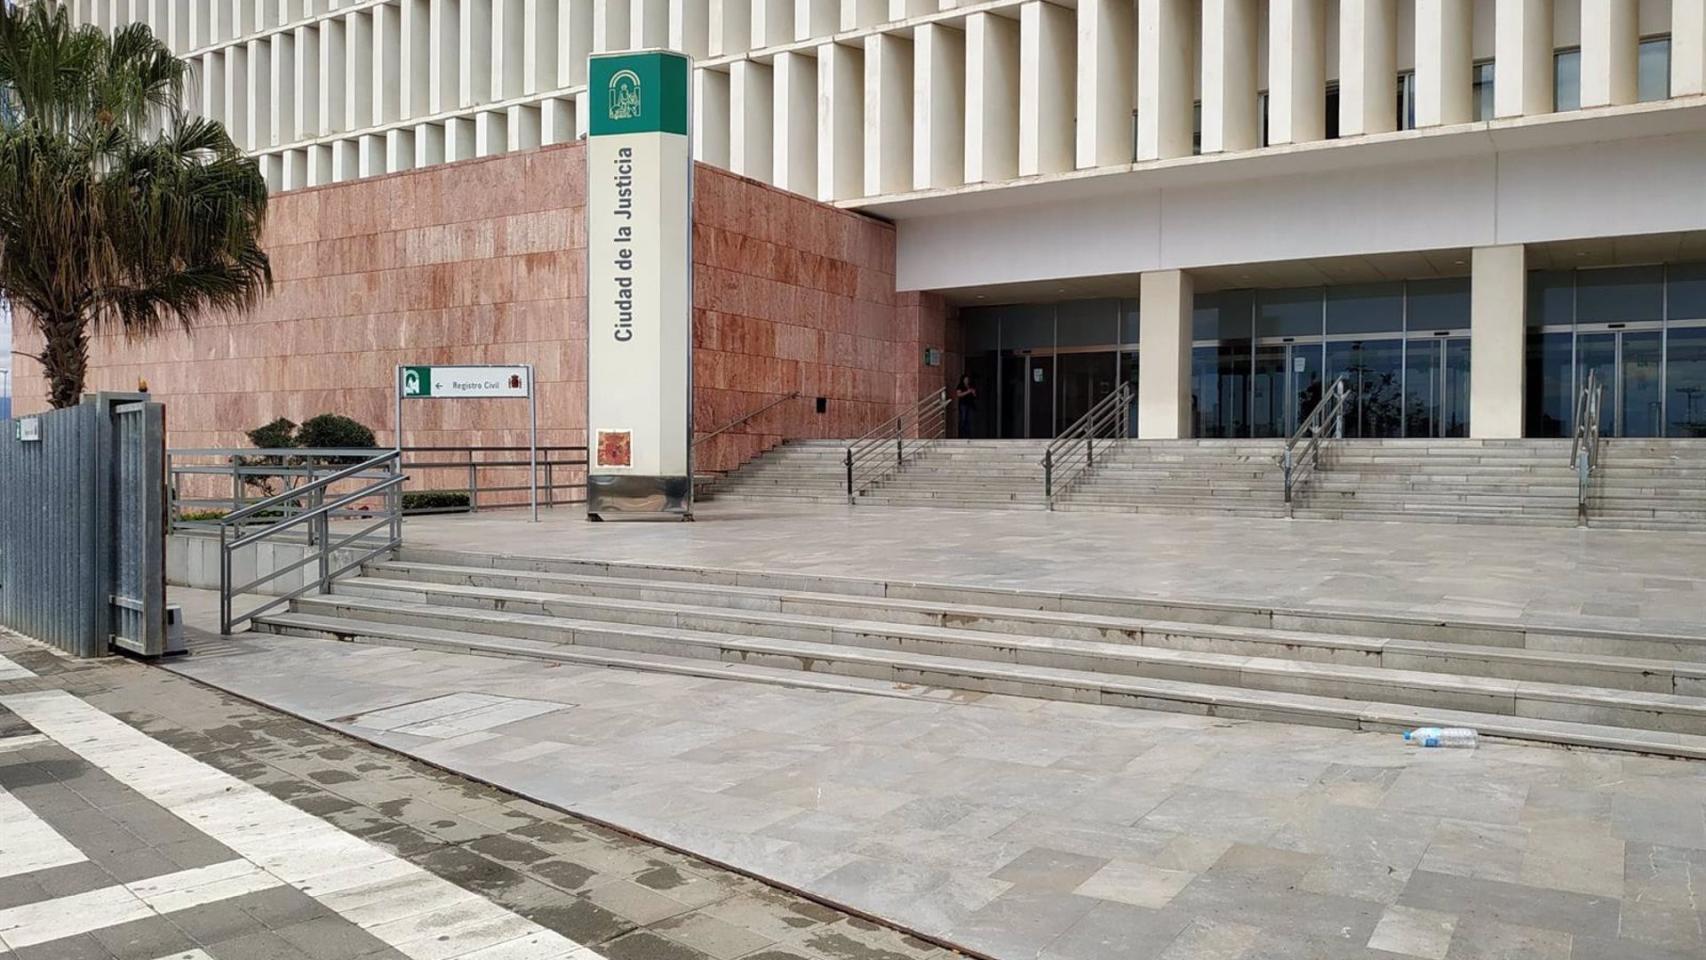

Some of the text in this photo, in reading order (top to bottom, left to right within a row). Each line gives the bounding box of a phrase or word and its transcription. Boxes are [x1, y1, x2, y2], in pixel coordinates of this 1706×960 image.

[613, 147, 632, 342] Ciudad de la Justicia
[452, 381, 500, 391] Registro Civil
